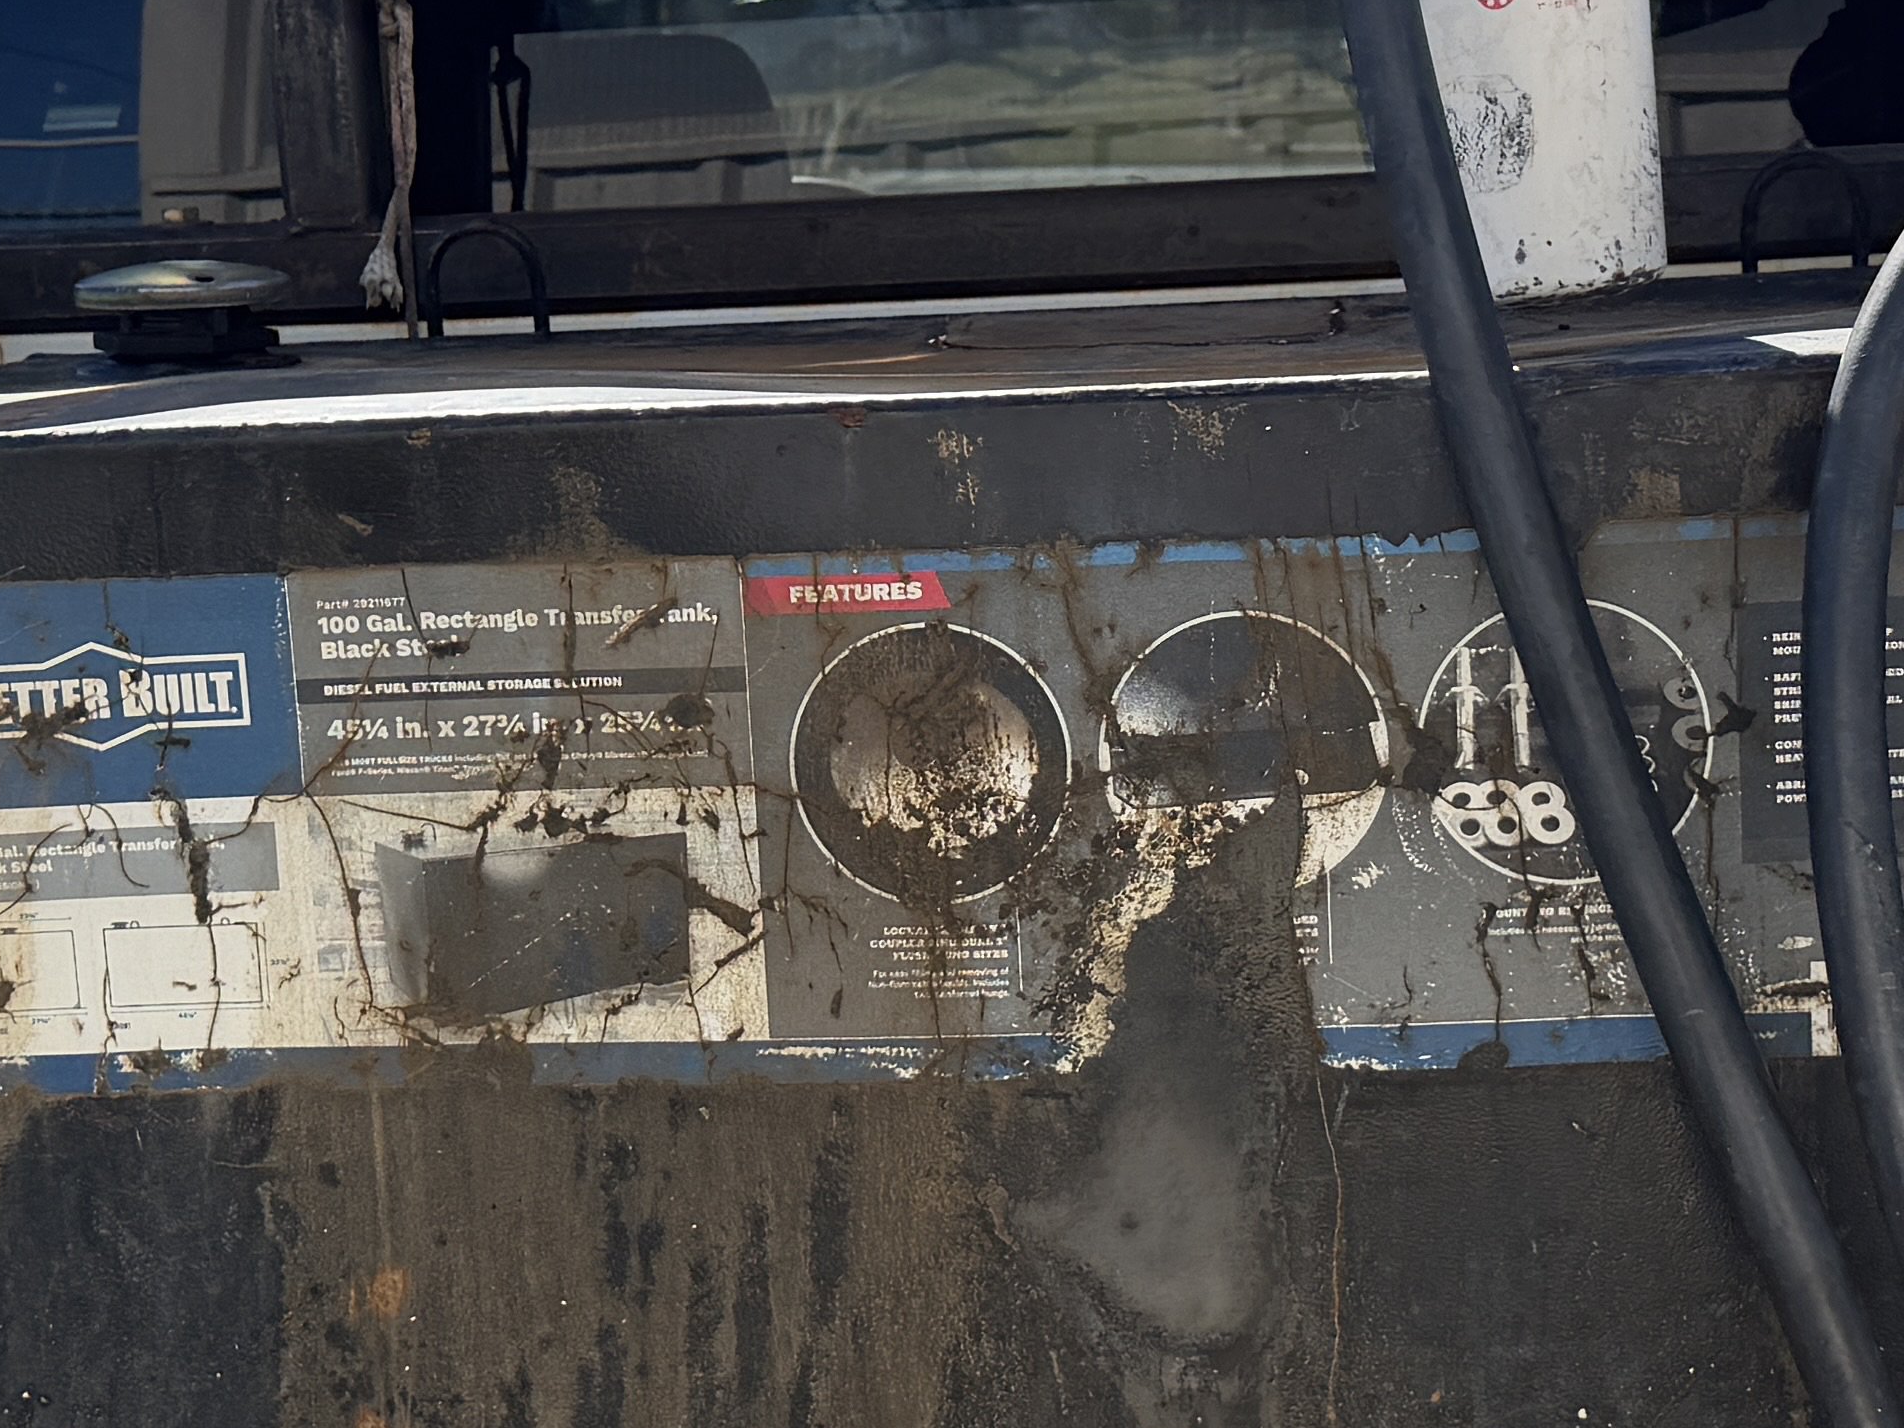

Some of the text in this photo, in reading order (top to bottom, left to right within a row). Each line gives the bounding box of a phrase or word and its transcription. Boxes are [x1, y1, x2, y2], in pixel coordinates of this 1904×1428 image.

[789, 581, 923, 604] FEATURES
[316, 599, 349, 610] Part#
[317, 615, 360, 634] 100
[366, 613, 413, 632] Gal.
[420, 609, 538, 632] Rectangle
[653, 602, 718, 625] ank,
[321, 638, 392, 659] Black
[119, 668, 236, 718] BUILT
[323, 684, 372, 696] DIESEL
[375, 682, 409, 694] FUEL
[412, 680, 484, 693] EXTERNAL
[487, 677, 551, 691] STORAGE
[396, 716, 429, 739] in.
[438, 720, 456, 738] x
[109, 837, 176, 853] Transfer
